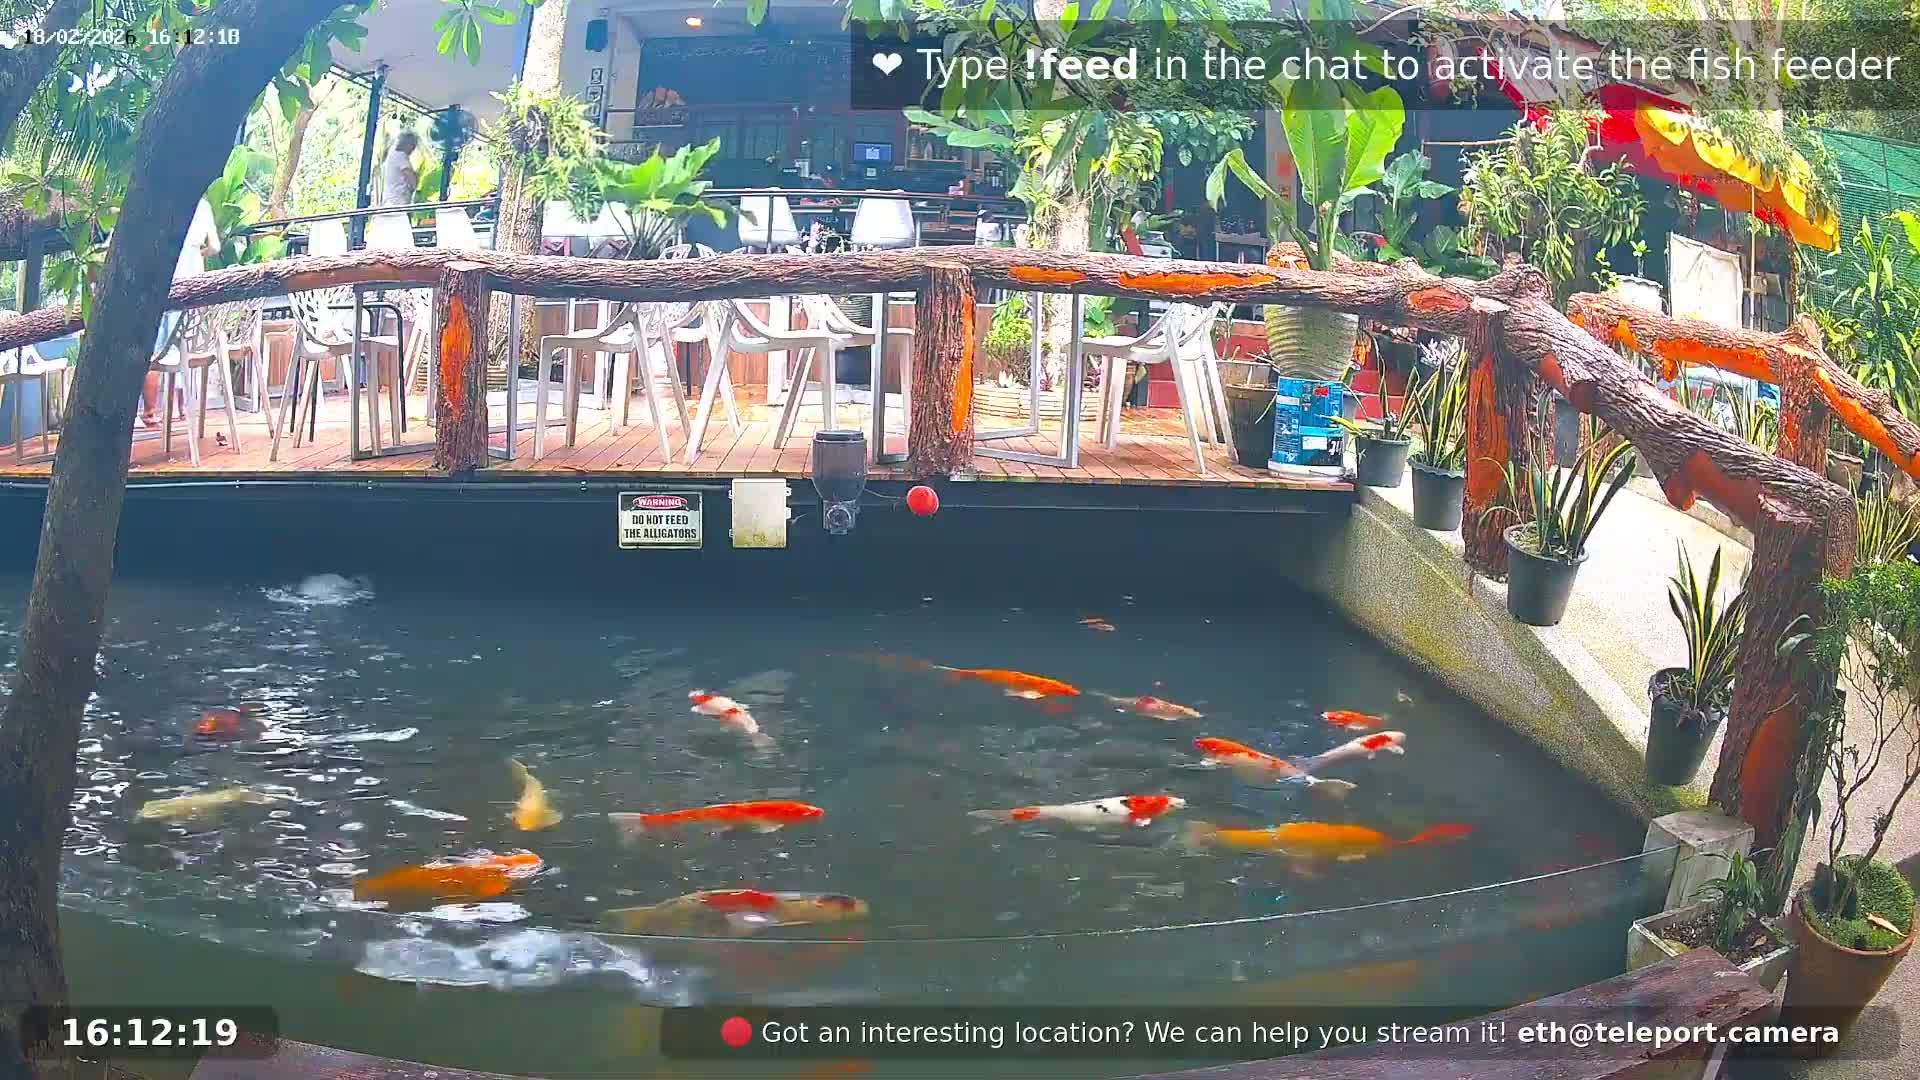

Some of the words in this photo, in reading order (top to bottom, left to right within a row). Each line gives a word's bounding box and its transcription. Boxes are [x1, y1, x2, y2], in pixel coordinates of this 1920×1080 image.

[638, 497, 681, 506] WARNING
[632, 515, 644, 524] DO
[646, 515, 663, 525] NOT
[666, 515, 688, 525] FEED
[624, 528, 641, 538] THE
[643, 528, 697, 539] ALLIGATORS
